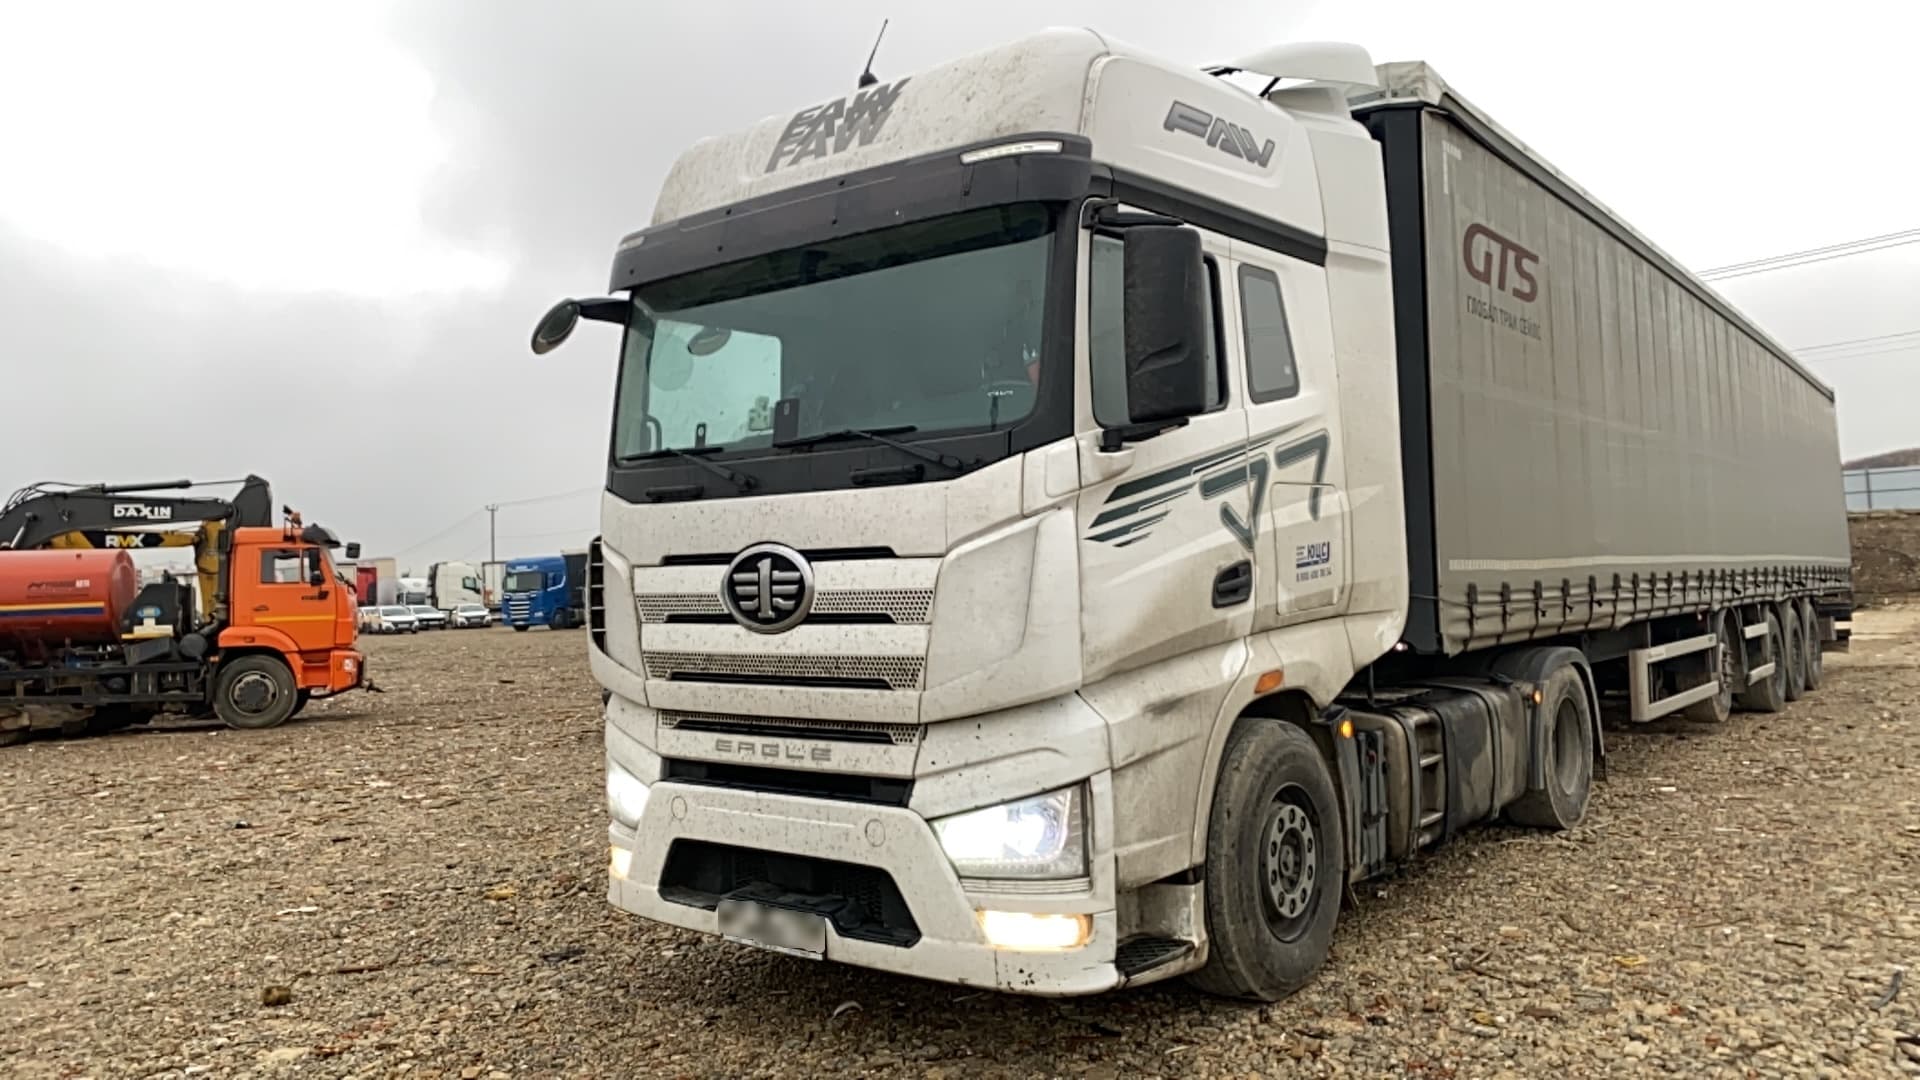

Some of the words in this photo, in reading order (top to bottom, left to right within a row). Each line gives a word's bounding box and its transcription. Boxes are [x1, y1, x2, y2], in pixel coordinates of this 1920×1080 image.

[1163, 99, 1275, 168] FAW
[1463, 223, 1540, 303] GTS
[113, 503, 172, 520] DAXIN
[105, 533, 146, 548] RMX
[715, 739, 833, 763] EAGLE
